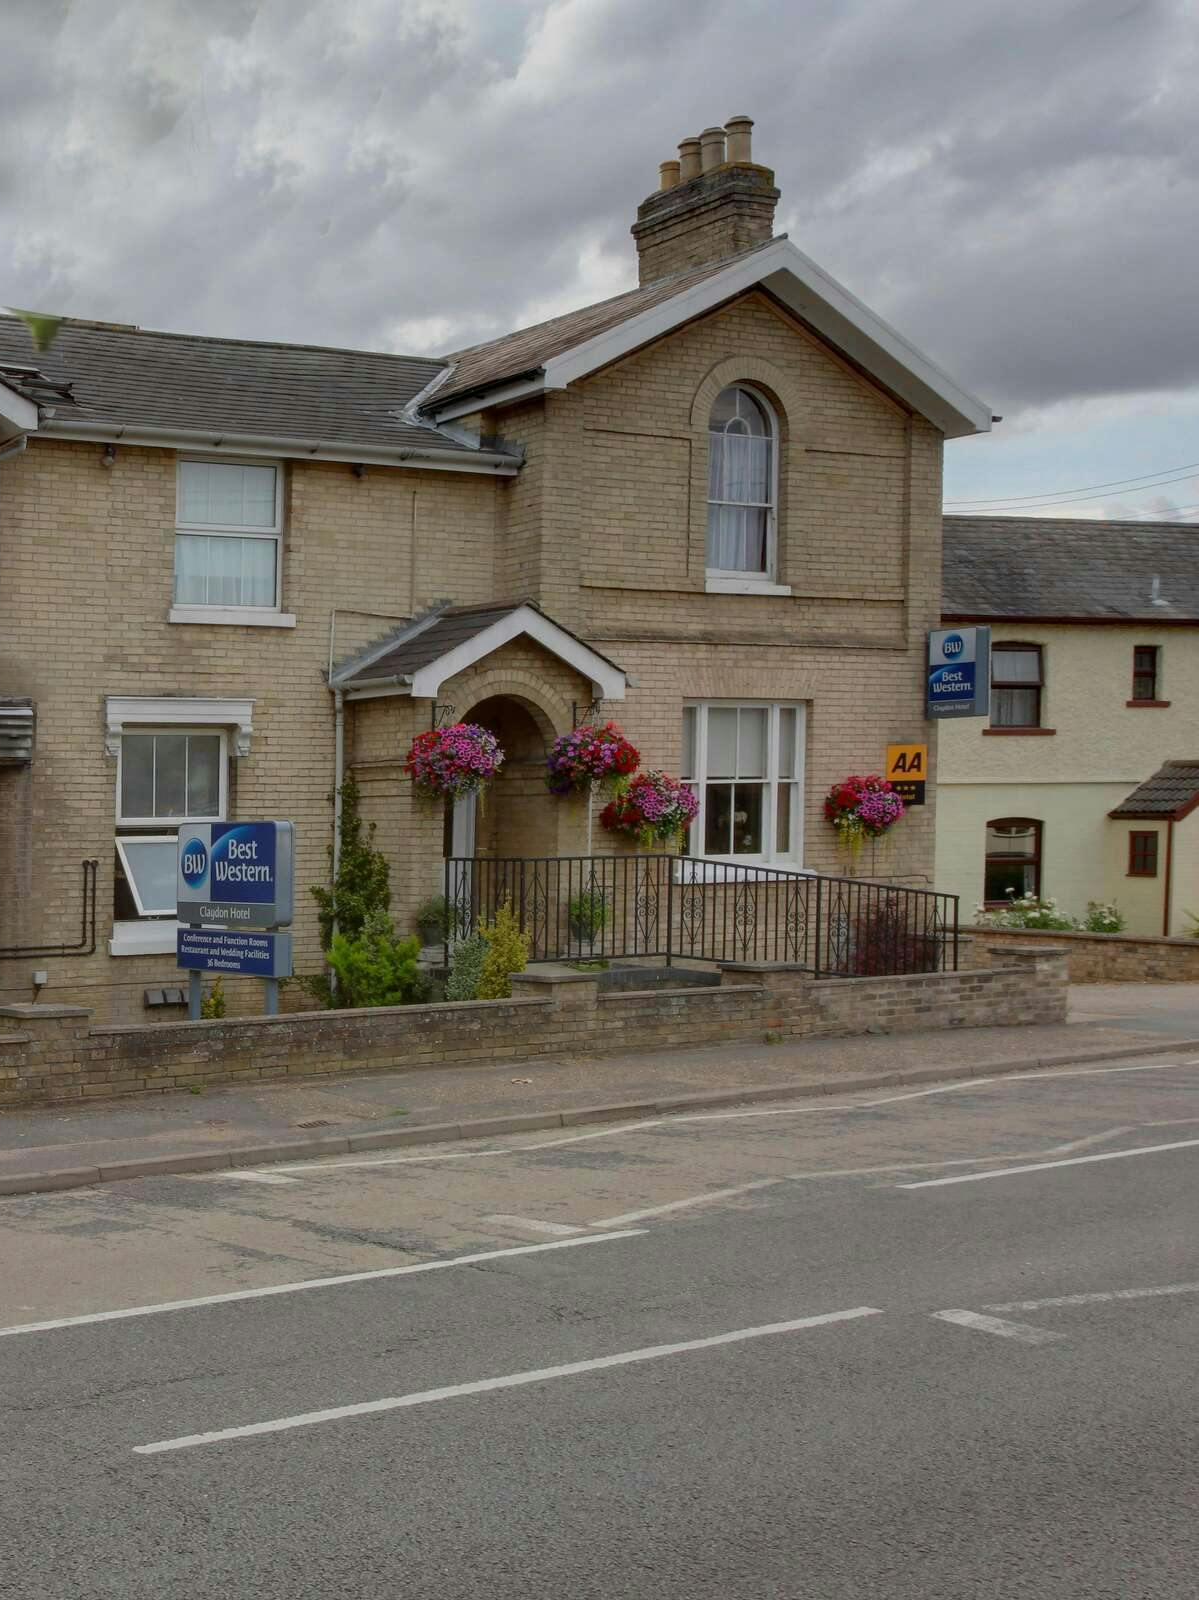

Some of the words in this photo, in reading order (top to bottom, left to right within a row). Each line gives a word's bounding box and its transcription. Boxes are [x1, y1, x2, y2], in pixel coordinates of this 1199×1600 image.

[944, 641, 961, 653] BW
[942, 672, 962, 681] Best
[892, 752, 922, 773] AA
[228, 839, 258, 859] Best
[185, 854, 206, 874] BW
[200, 906, 228, 920] Claydon
[230, 907, 250, 919] Hotel
[183, 934, 212, 944] Conference
[213, 936, 223, 944] and
[224, 937, 248, 945] Function
[249, 938, 268, 947] Rooms
[181, 945, 209, 954] Restaurant
[210, 947, 220, 955] and
[221, 948, 244, 959] Wedding
[245, 950, 269, 959] Facilities
[207, 959, 213, 967] 36
[214, 960, 240, 969] Bedrooms
